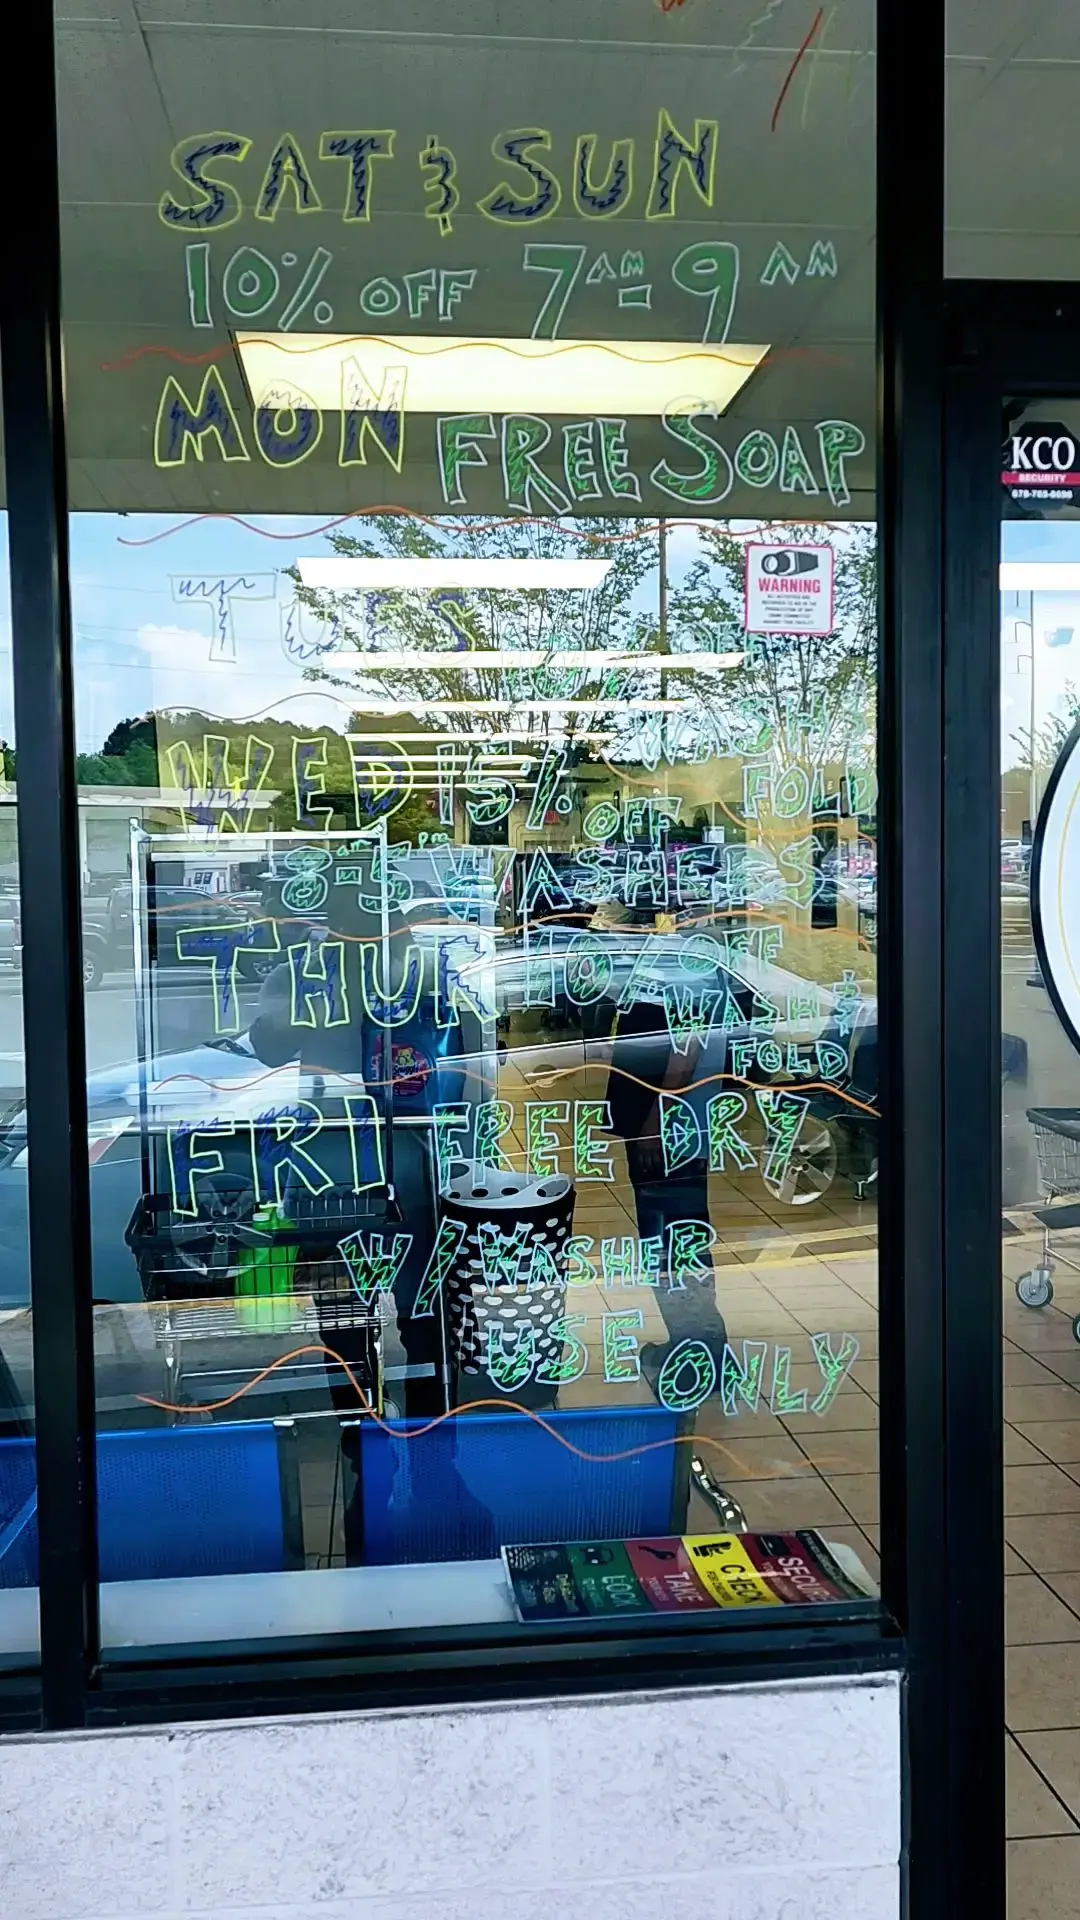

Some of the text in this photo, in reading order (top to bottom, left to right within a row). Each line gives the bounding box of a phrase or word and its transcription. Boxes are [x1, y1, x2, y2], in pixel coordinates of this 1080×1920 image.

[159, 128, 396, 232] SAT
[478, 107, 720, 226] SUN
[185, 242, 333, 331] 10%
[360, 268, 477, 321] OFF
[153, 356, 409, 474] MON
[436, 412, 642, 515] FREE
[1011, 436, 1076, 470] KCO
[1018, 473, 1067, 484] SECURITY
[168, 572, 480, 670] TUES
[758, 577, 821, 593] WARNING
[633, 685, 834, 771] WASH
[165, 733, 574, 857] WED 15%
[582, 795, 683, 850] OFF
[741, 760, 879, 820] FOLD
[175, 916, 501, 1036] THUR
[678, 925, 785, 980] OFF
[661, 980, 822, 1055] WASH
[728, 1038, 850, 1080] FOLD
[164, 1089, 812, 1218] FRI FREE DRY
[485, 1308, 862, 1416] USE ONLY
[600, 1574, 641, 1607] LOCK
[662, 1571, 704, 1603] TAKE
[775, 1556, 835, 1602] SECURE
